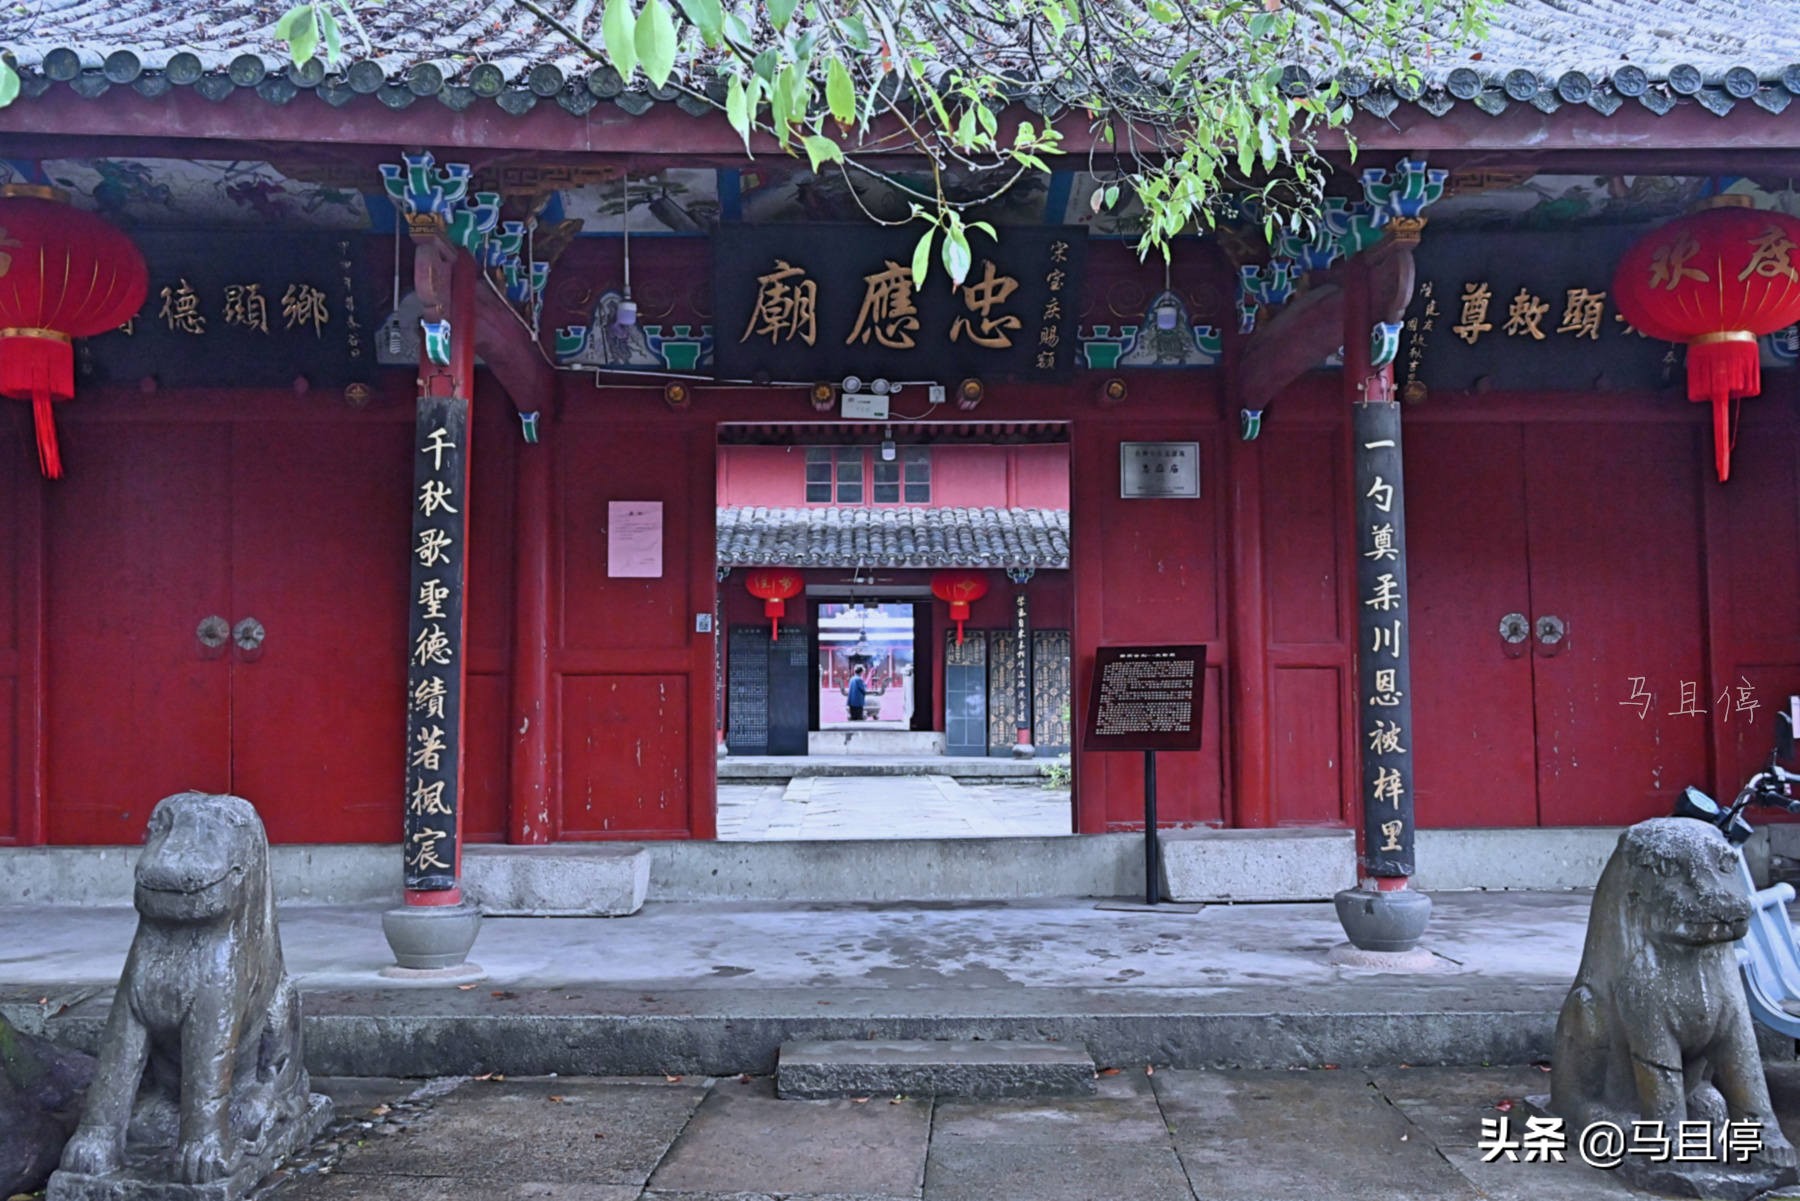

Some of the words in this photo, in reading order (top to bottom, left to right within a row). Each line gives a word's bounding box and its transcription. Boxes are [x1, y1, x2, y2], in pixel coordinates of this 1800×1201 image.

[739, 259, 1022, 349] 忠應廟
[1364, 439, 1407, 851] 一勺奠柔川恩被梓里
